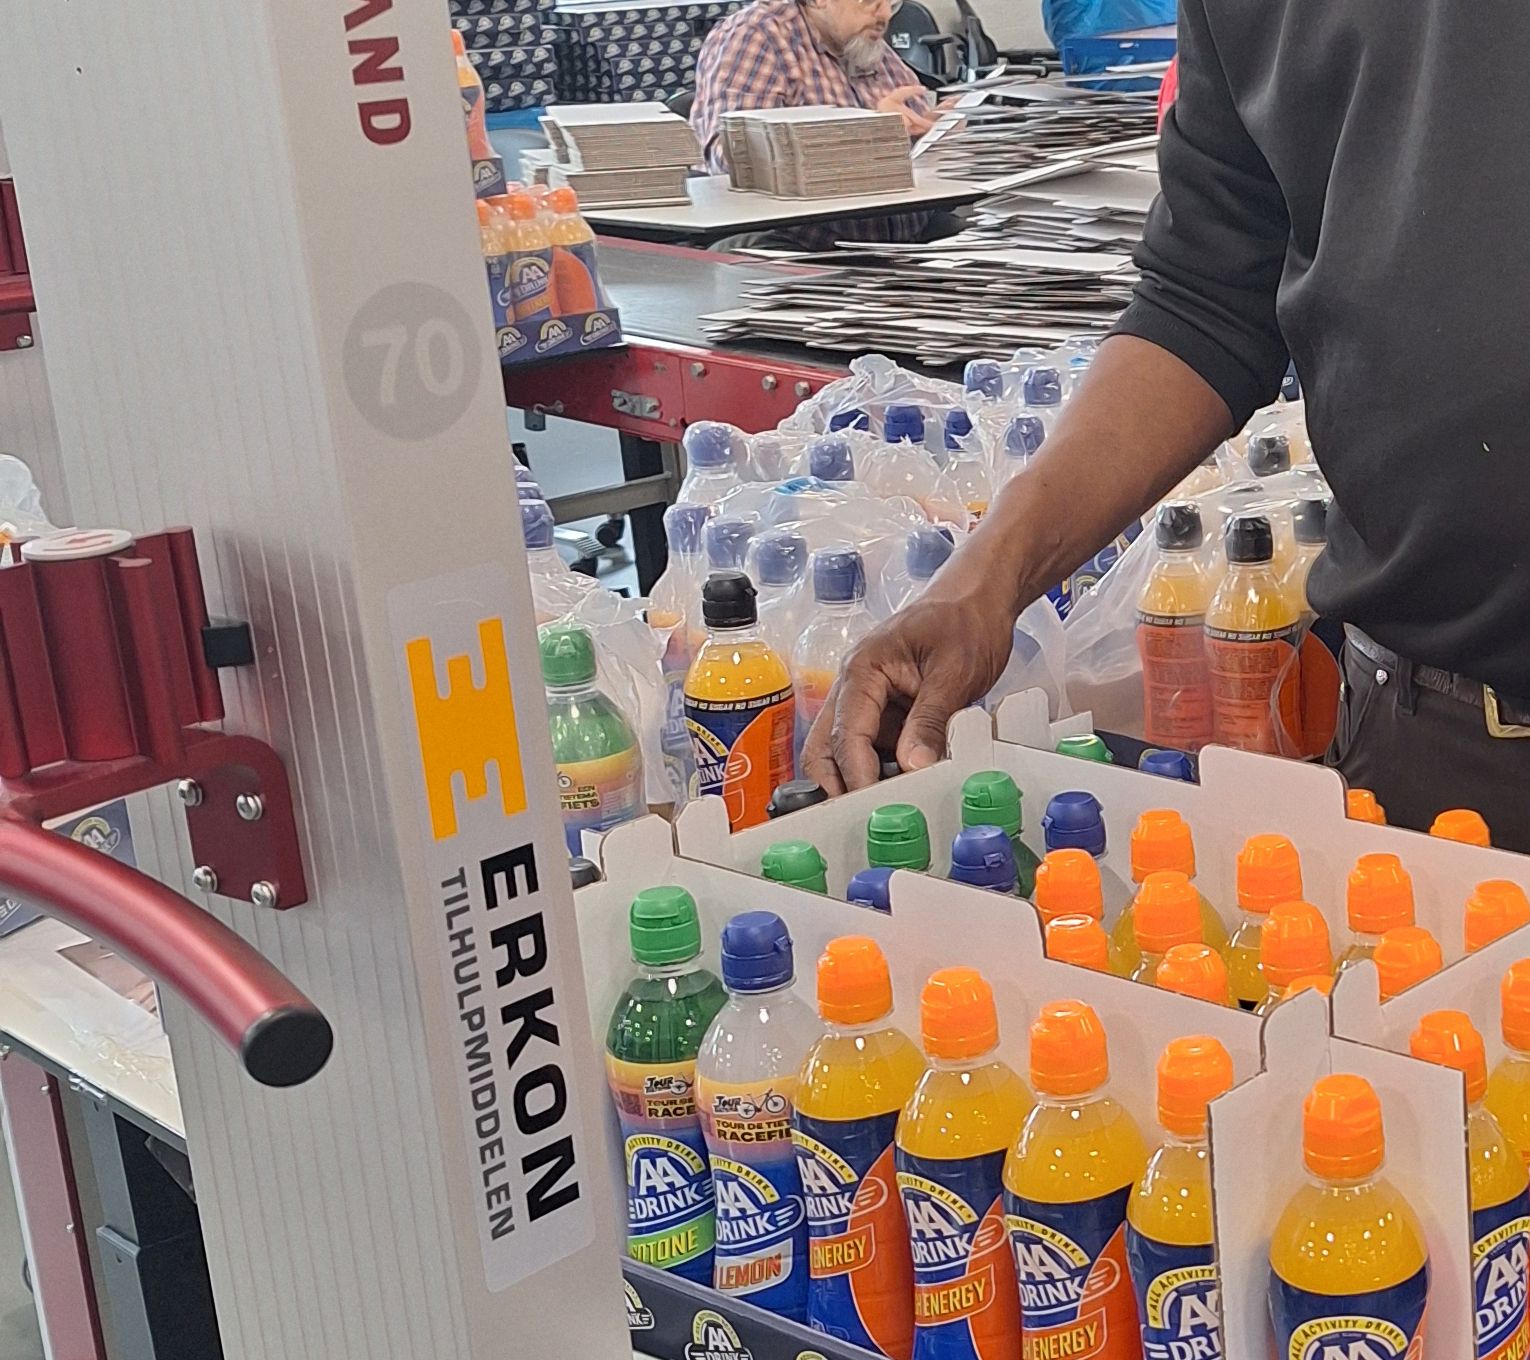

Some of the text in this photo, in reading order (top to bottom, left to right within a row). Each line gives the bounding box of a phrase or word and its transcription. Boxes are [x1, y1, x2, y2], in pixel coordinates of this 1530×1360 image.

[361, 316, 464, 405] 70
[748, 697, 770, 709] SUGAR
[480, 842, 580, 1223] ERKON
[441, 866, 514, 1241] TILHULPMIDDELEN
[716, 1120, 745, 1130] TOUR
[638, 1157, 689, 1196] AA
[636, 1185, 703, 1220] DRINK
[715, 1181, 762, 1219] AA
[807, 1192, 857, 1218] RINK
[906, 1199, 958, 1239] AA
[717, 1211, 776, 1241] DRINK
[912, 1232, 976, 1263] DRINK
[1017, 1242, 1068, 1281] AA
[719, 1253, 782, 1288] LEMON
[1149, 1267, 1215, 1312] ALL ACTIVITY
[924, 1278, 986, 1316] ENERGY
[1019, 1275, 1086, 1307] DRINK
[1477, 1273, 1528, 1336] DRIN
[709, 1326, 733, 1351] AA
[1292, 1320, 1400, 1360] ALL ACTIVITY DRINK
